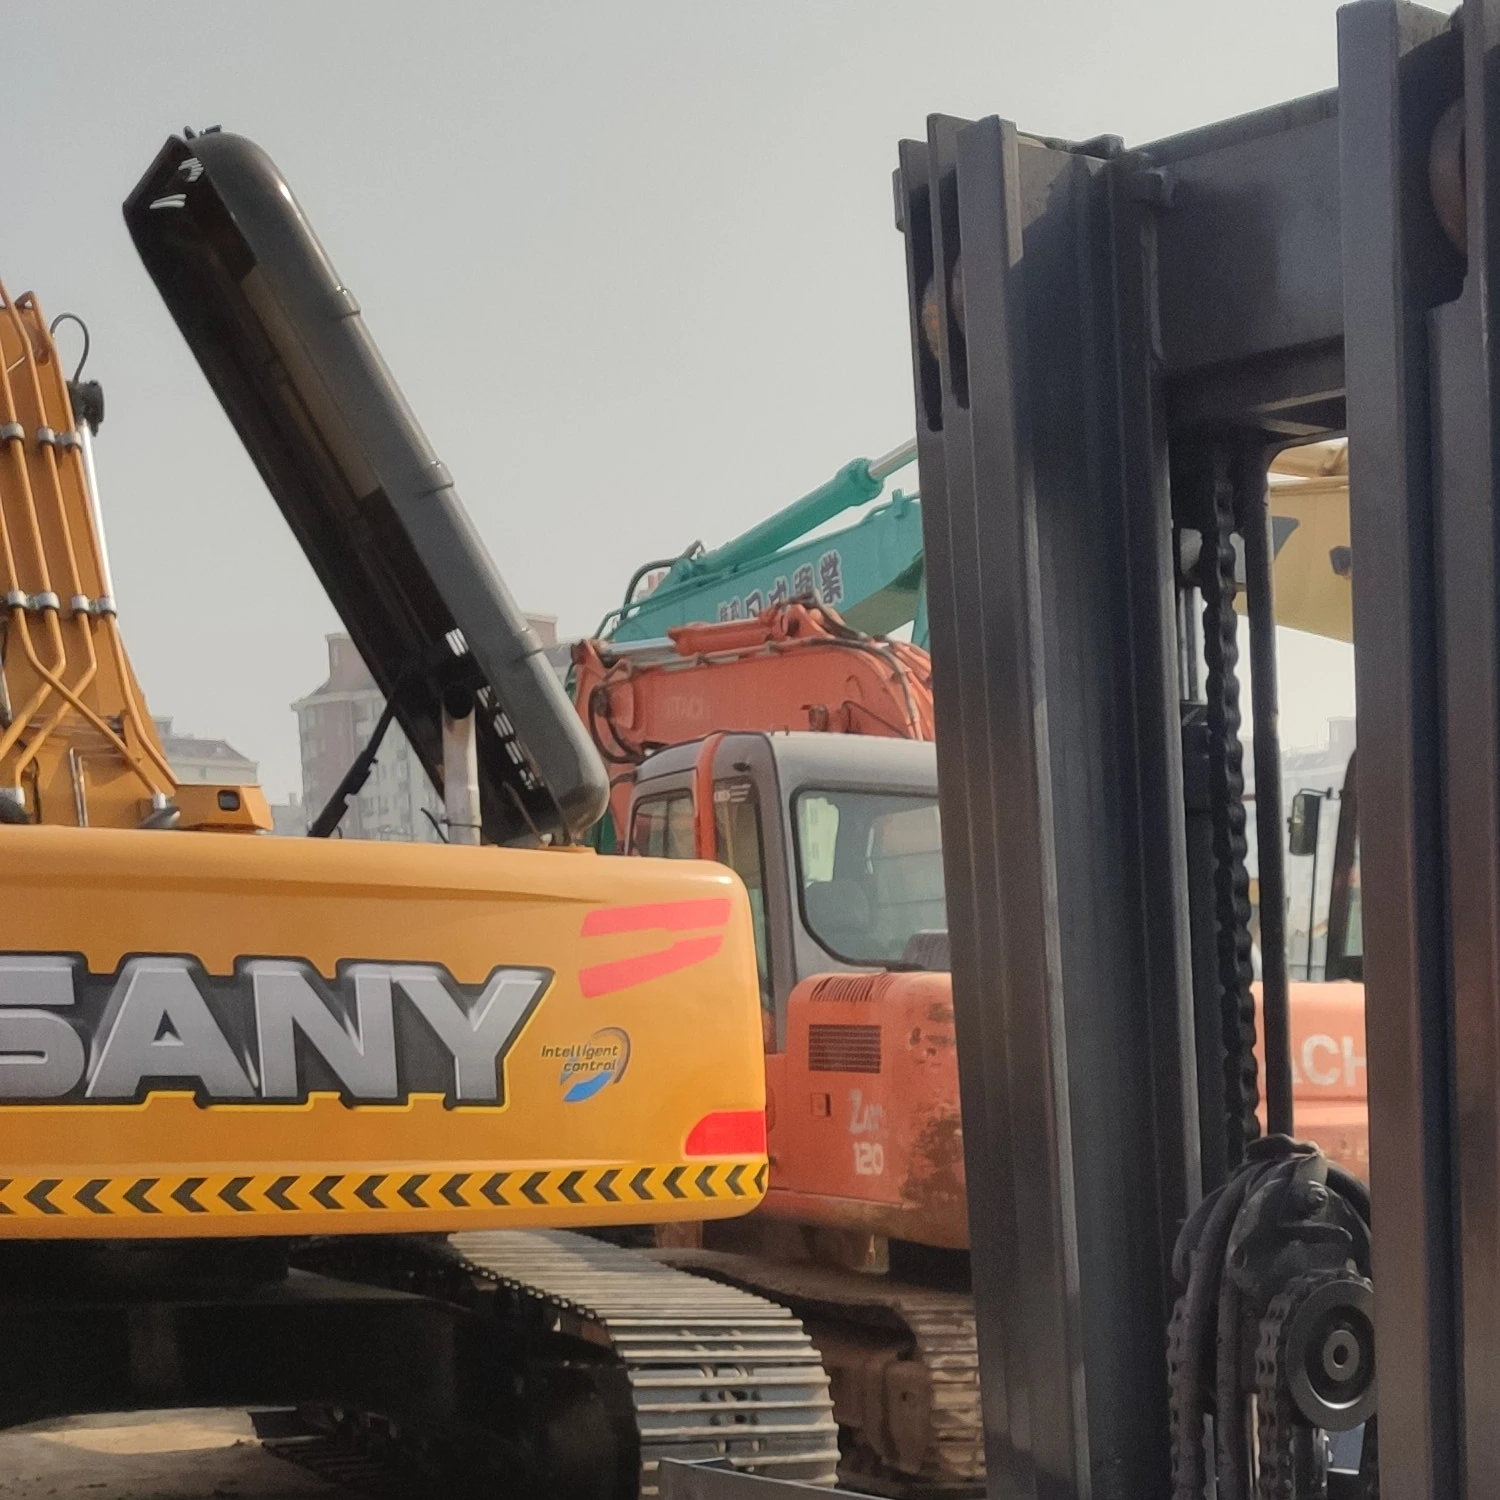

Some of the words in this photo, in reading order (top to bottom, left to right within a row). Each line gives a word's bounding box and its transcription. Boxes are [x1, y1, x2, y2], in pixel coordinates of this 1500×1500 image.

[0, 954, 551, 1106] SANY
[541, 1044, 619, 1060] Intelligent
[563, 1059, 616, 1072] control
